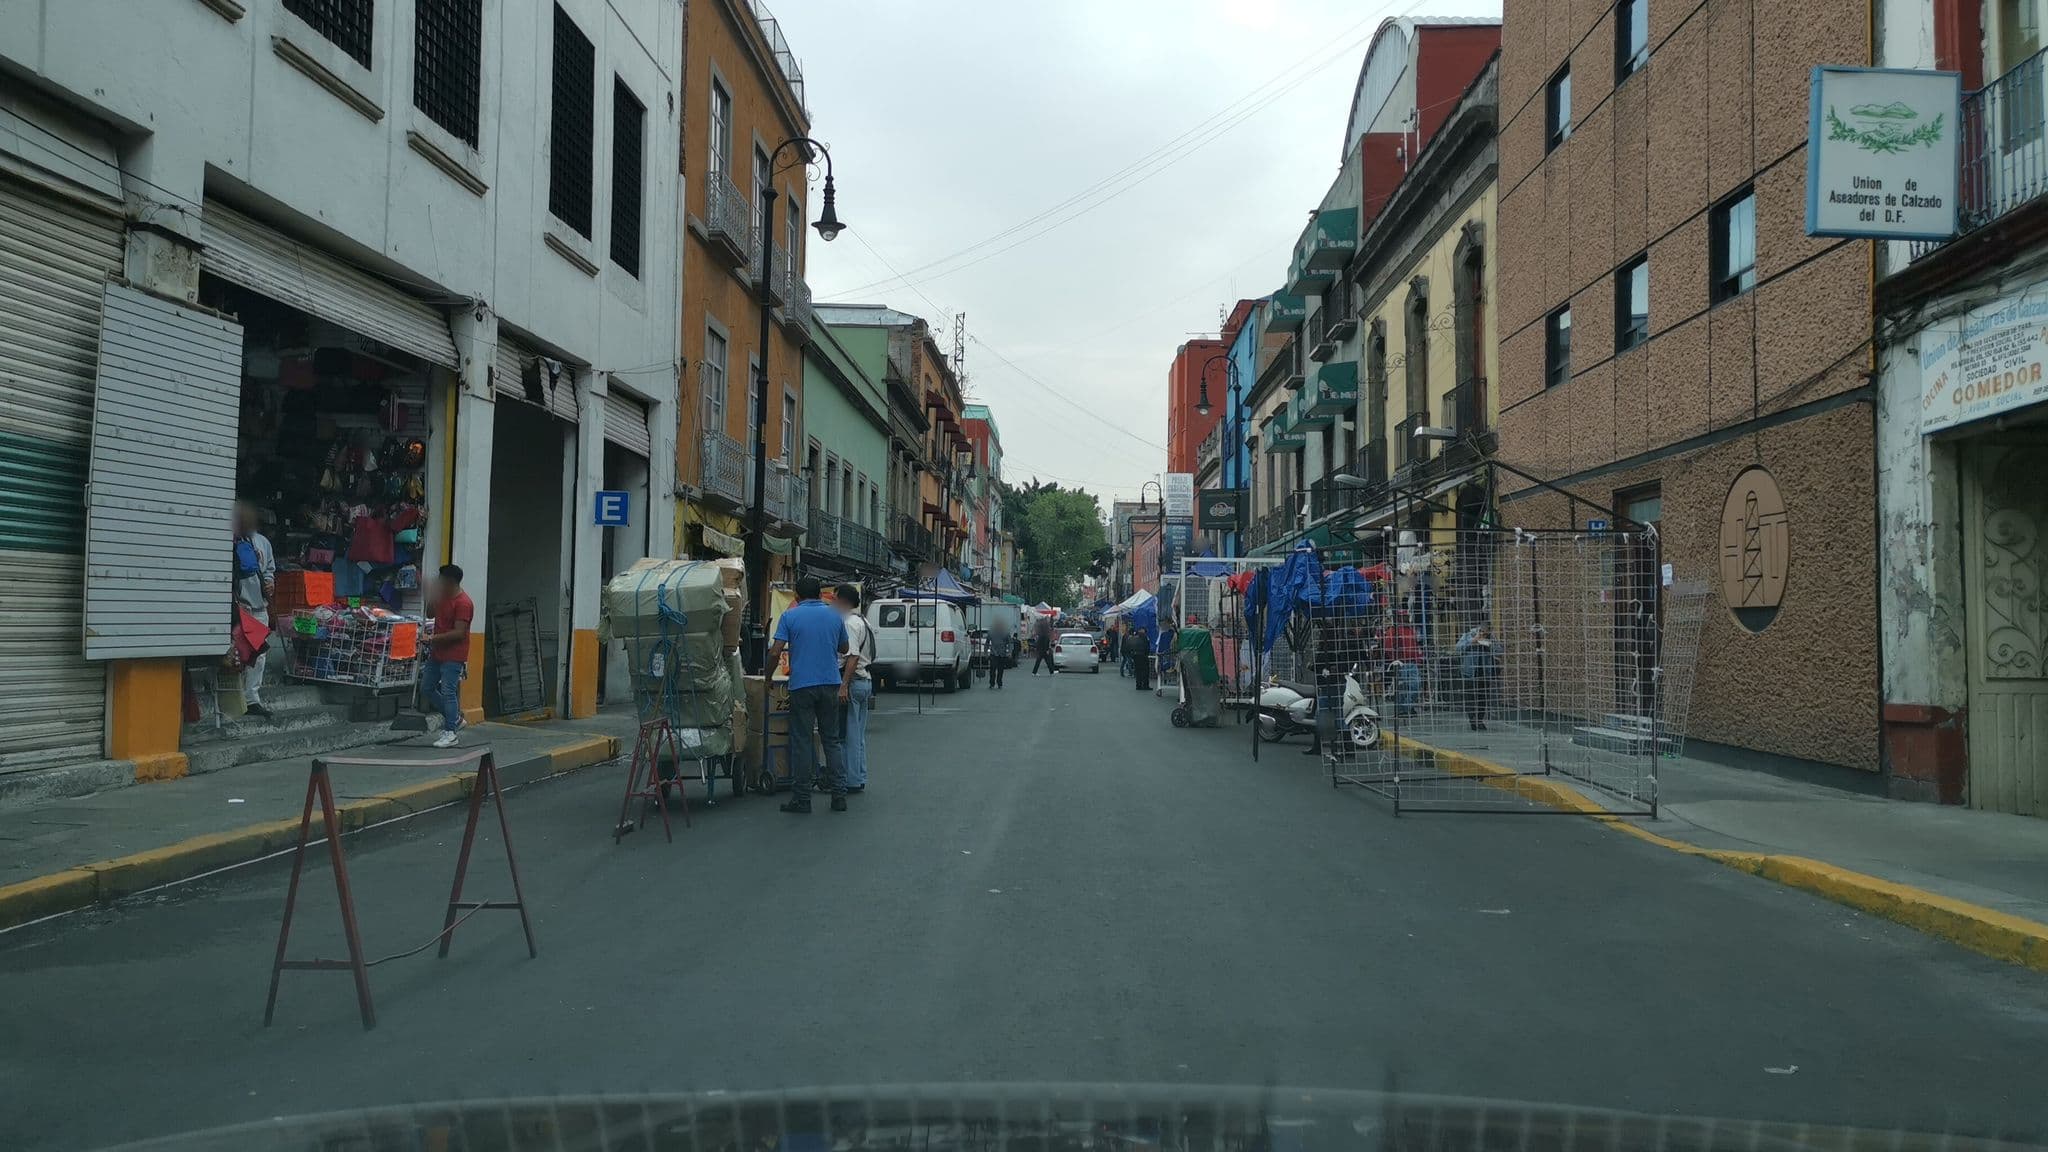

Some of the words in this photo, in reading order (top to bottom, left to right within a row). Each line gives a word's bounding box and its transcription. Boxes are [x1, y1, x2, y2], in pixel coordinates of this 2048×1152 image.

[1853, 176, 1882, 190] Union
[1905, 178, 1917, 191] de
[1829, 190, 1880, 206] Aseadores
[1885, 194, 1897, 207] de
[1901, 194, 1942, 209] Calzado
[1859, 209, 1875, 222] del
[1885, 210, 1905, 223] D.F.
[1966, 365, 1997, 382] SOCIEDAD
[2004, 356, 2026, 369] CIVIL
[1922, 371, 1949, 410] COCINA
[1952, 362, 2042, 405] COMEDOR
[602, 496, 621, 520] E
